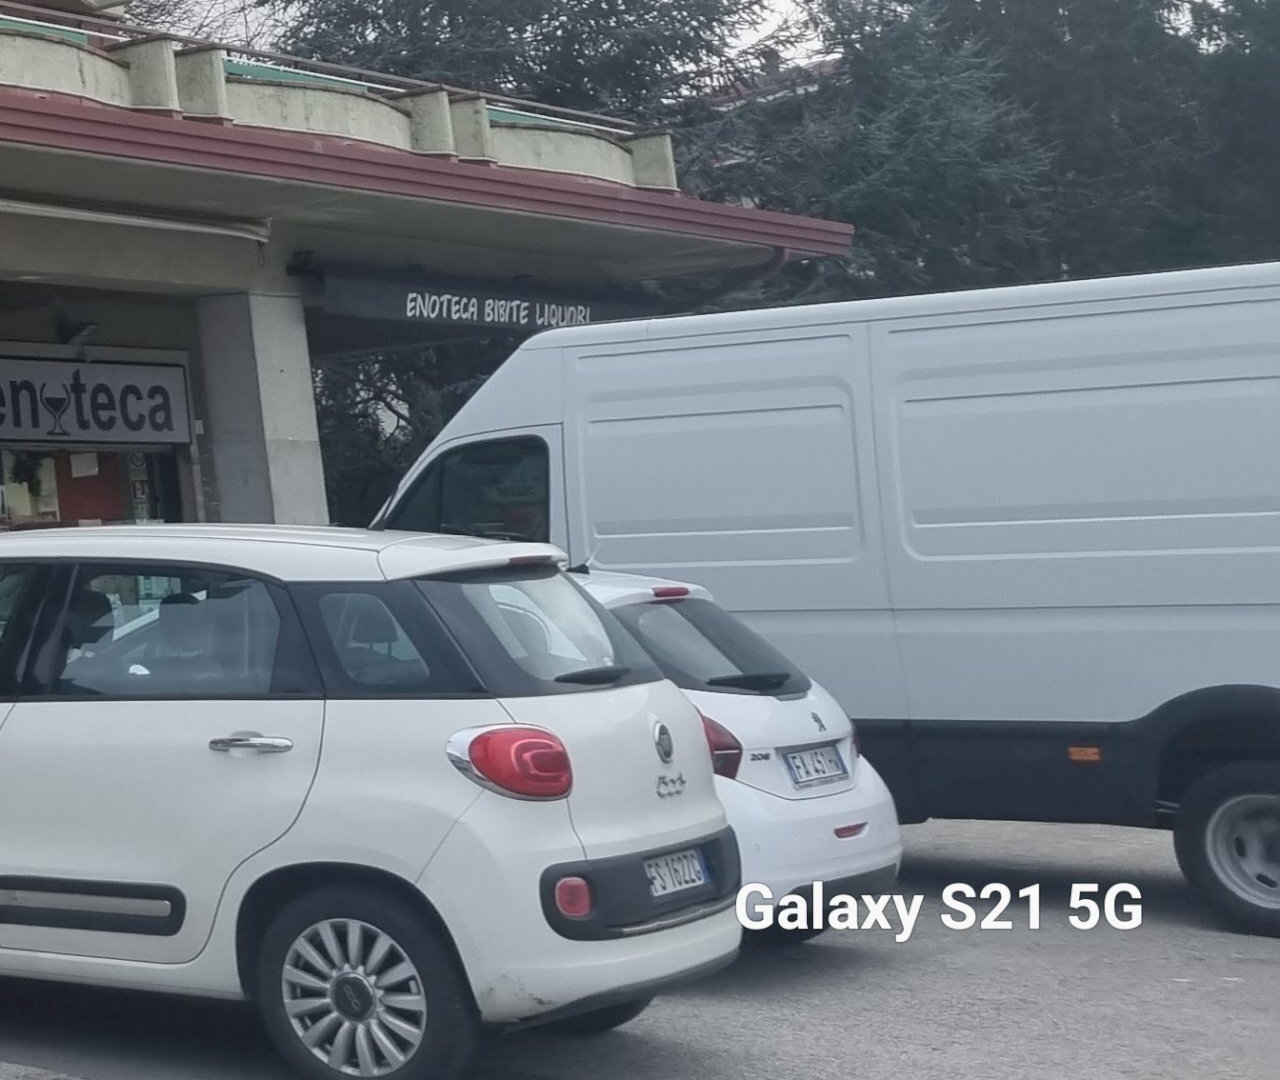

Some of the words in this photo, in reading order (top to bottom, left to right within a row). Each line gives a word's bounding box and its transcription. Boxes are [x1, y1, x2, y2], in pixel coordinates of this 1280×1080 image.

[406, 292, 478, 320] ENOTECA
[484, 299, 530, 325] BIBITE
[535, 303, 590, 327] LIQUORI
